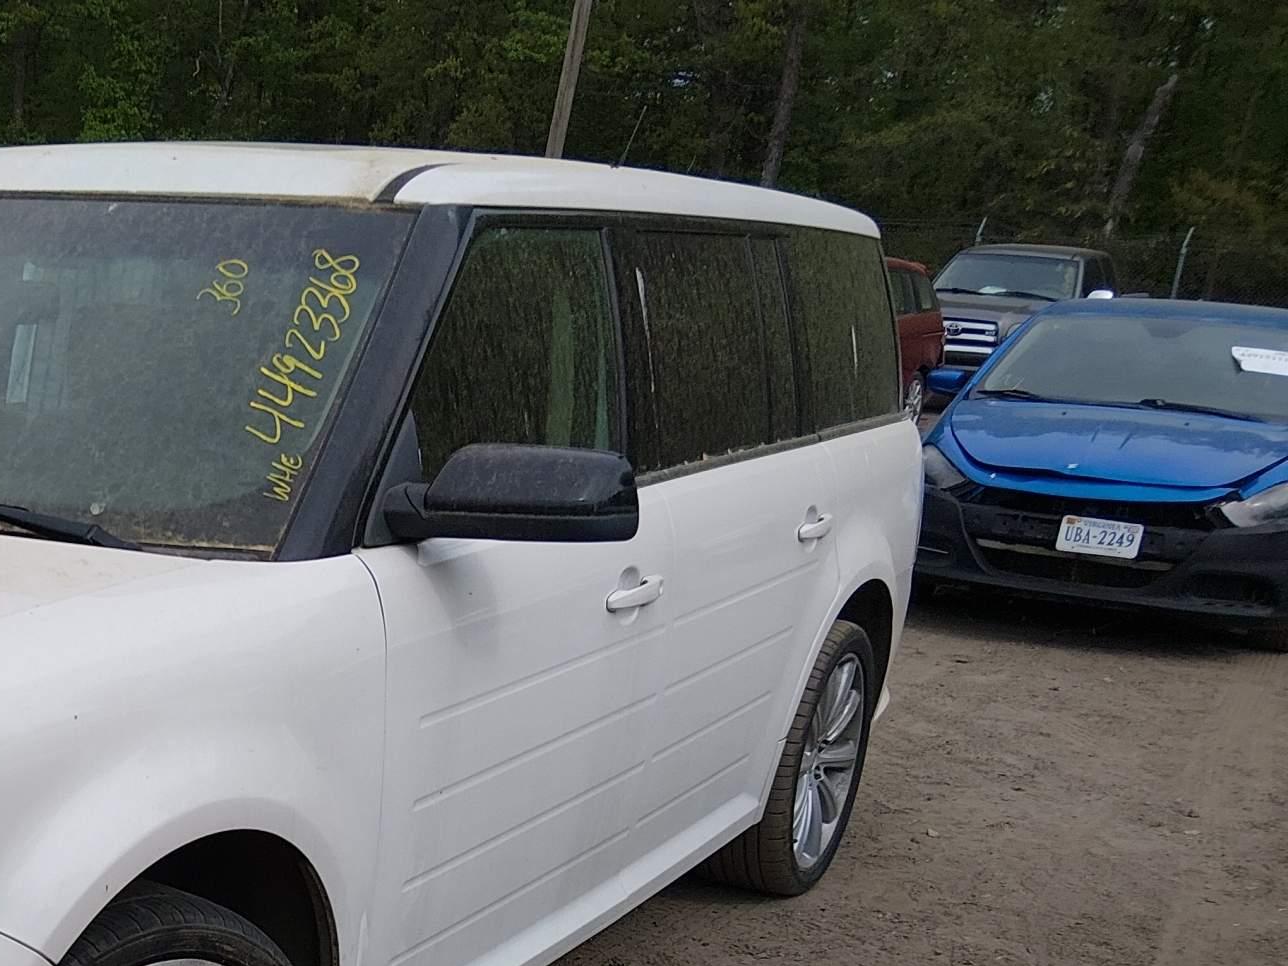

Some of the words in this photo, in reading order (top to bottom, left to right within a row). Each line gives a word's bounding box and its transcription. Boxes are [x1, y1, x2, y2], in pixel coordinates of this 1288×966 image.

[196, 258, 249, 317] 360
[244, 248, 360, 444] 44923368
[1064, 526, 1135, 548] UBA-2249
